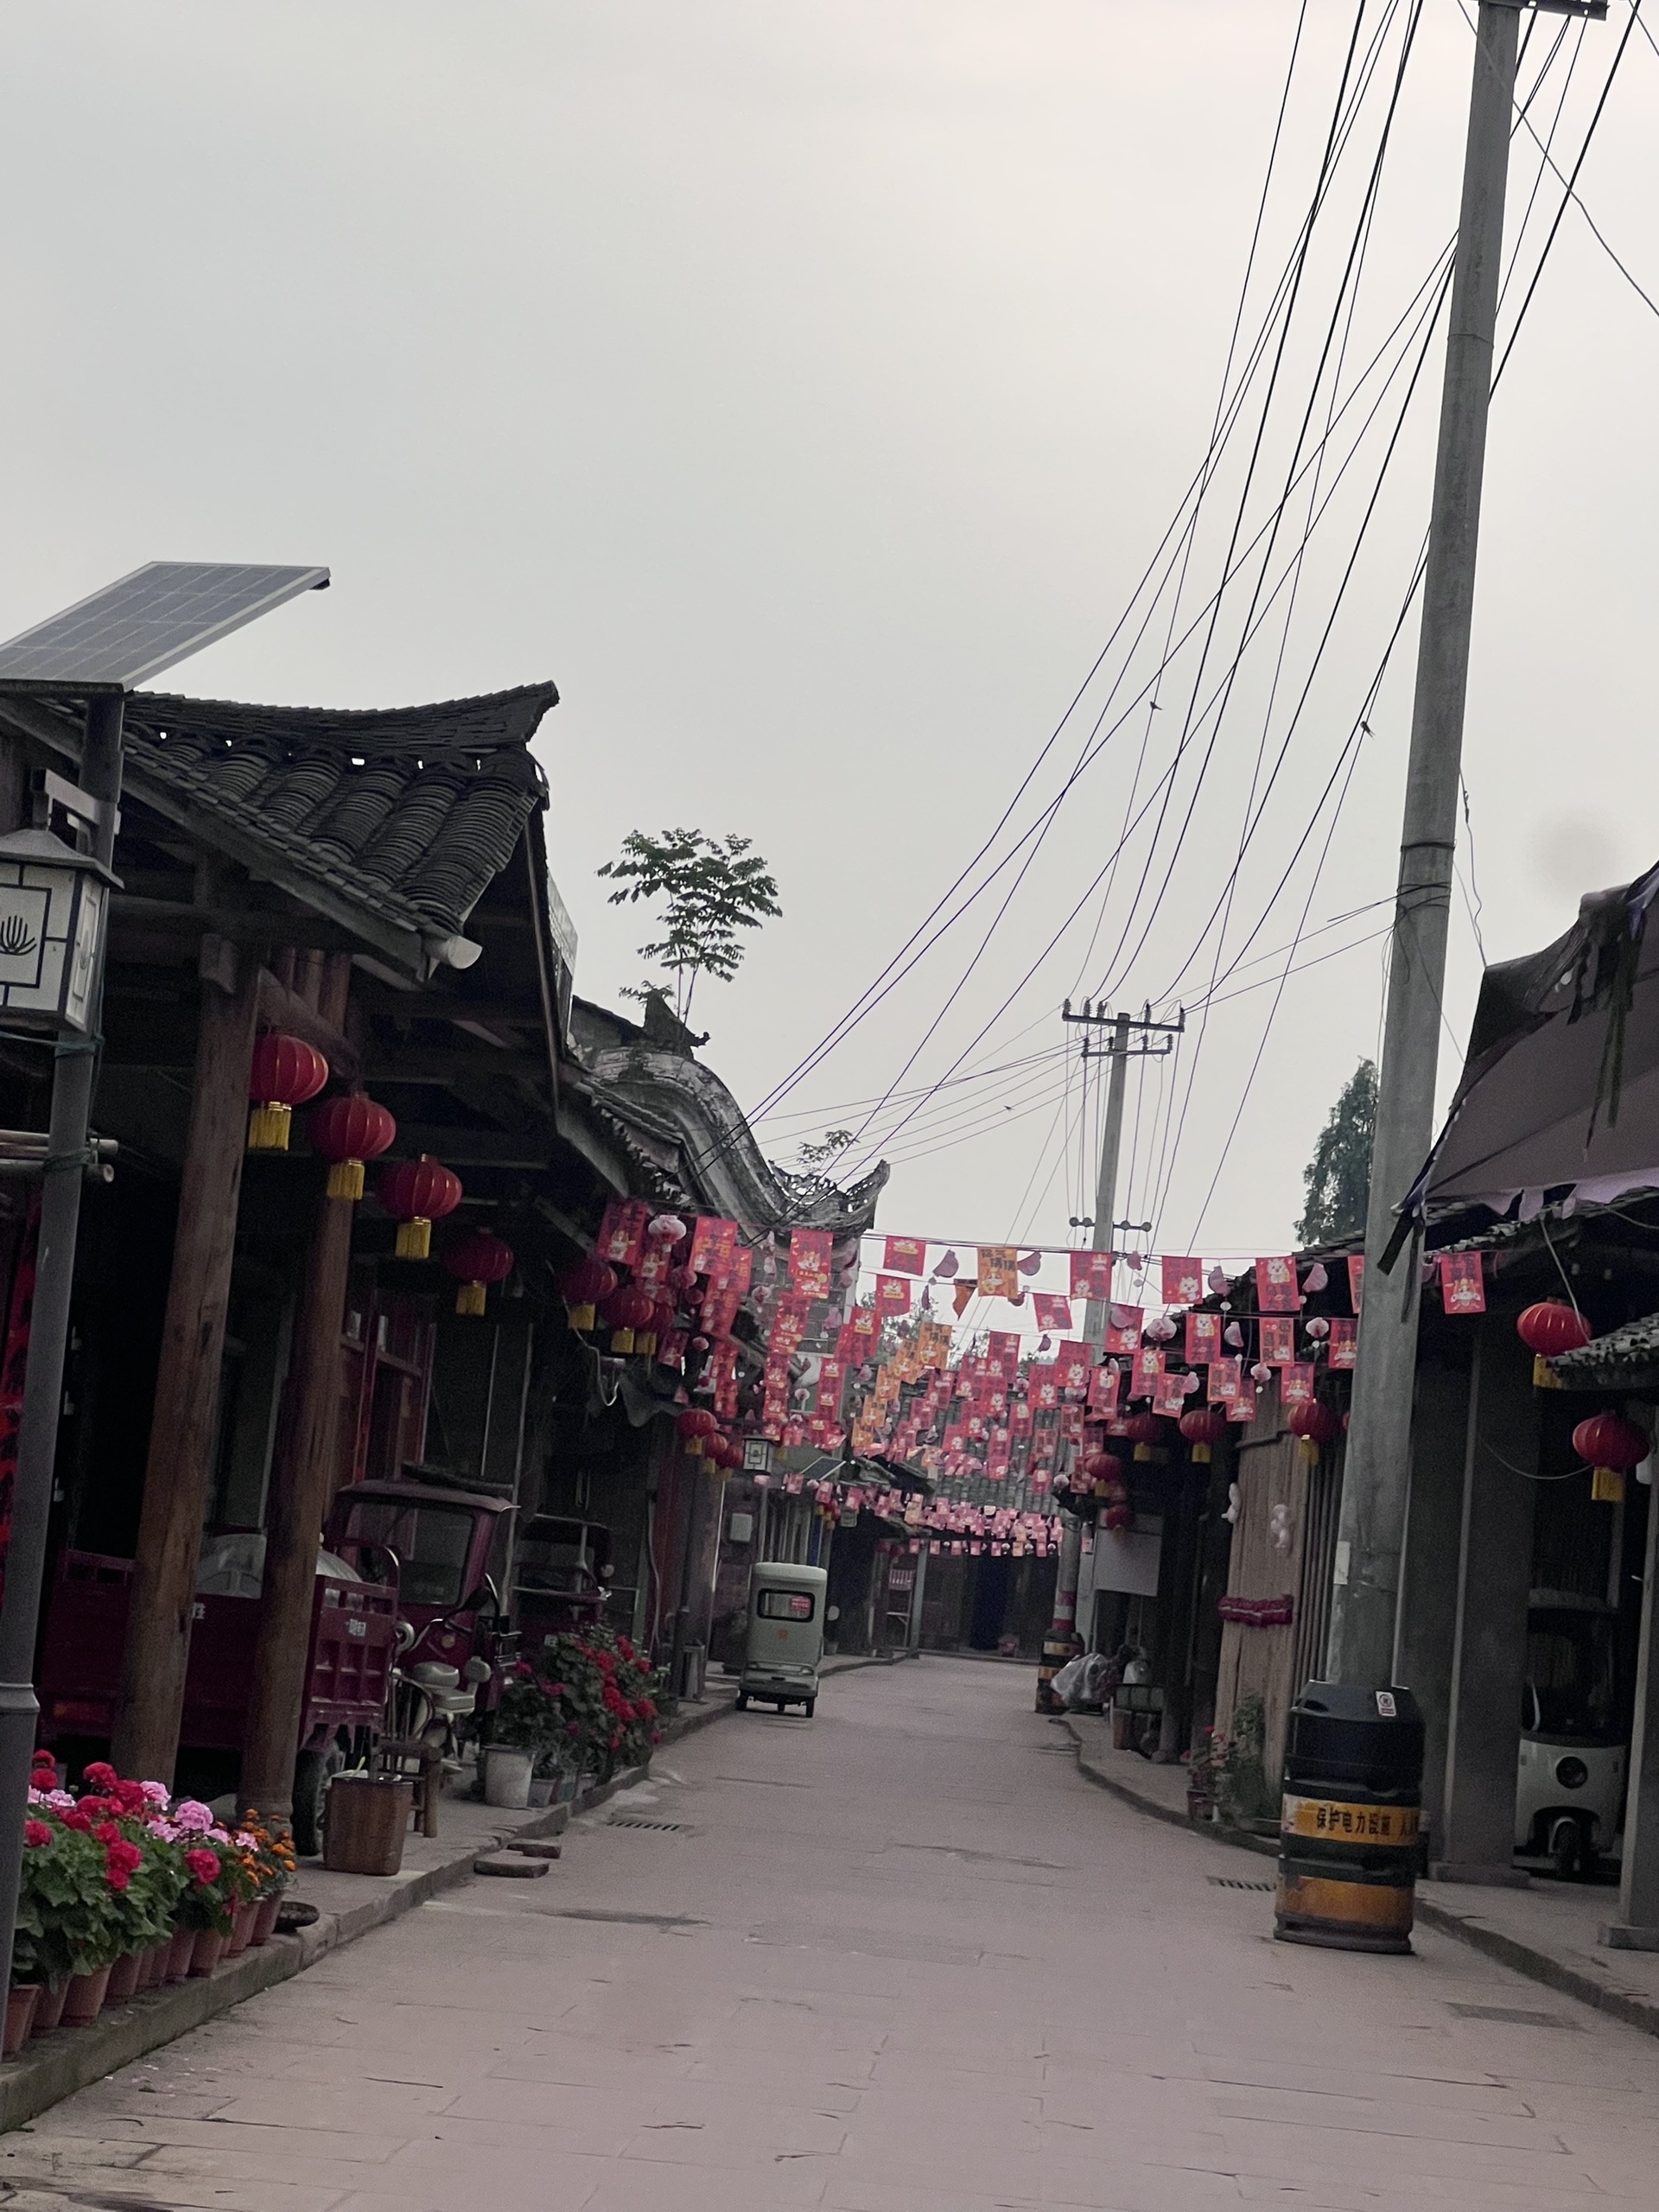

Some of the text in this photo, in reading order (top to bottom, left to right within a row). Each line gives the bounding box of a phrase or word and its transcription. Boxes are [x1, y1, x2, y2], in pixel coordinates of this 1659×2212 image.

[1317, 1807, 1391, 1836] 保护电力设施
